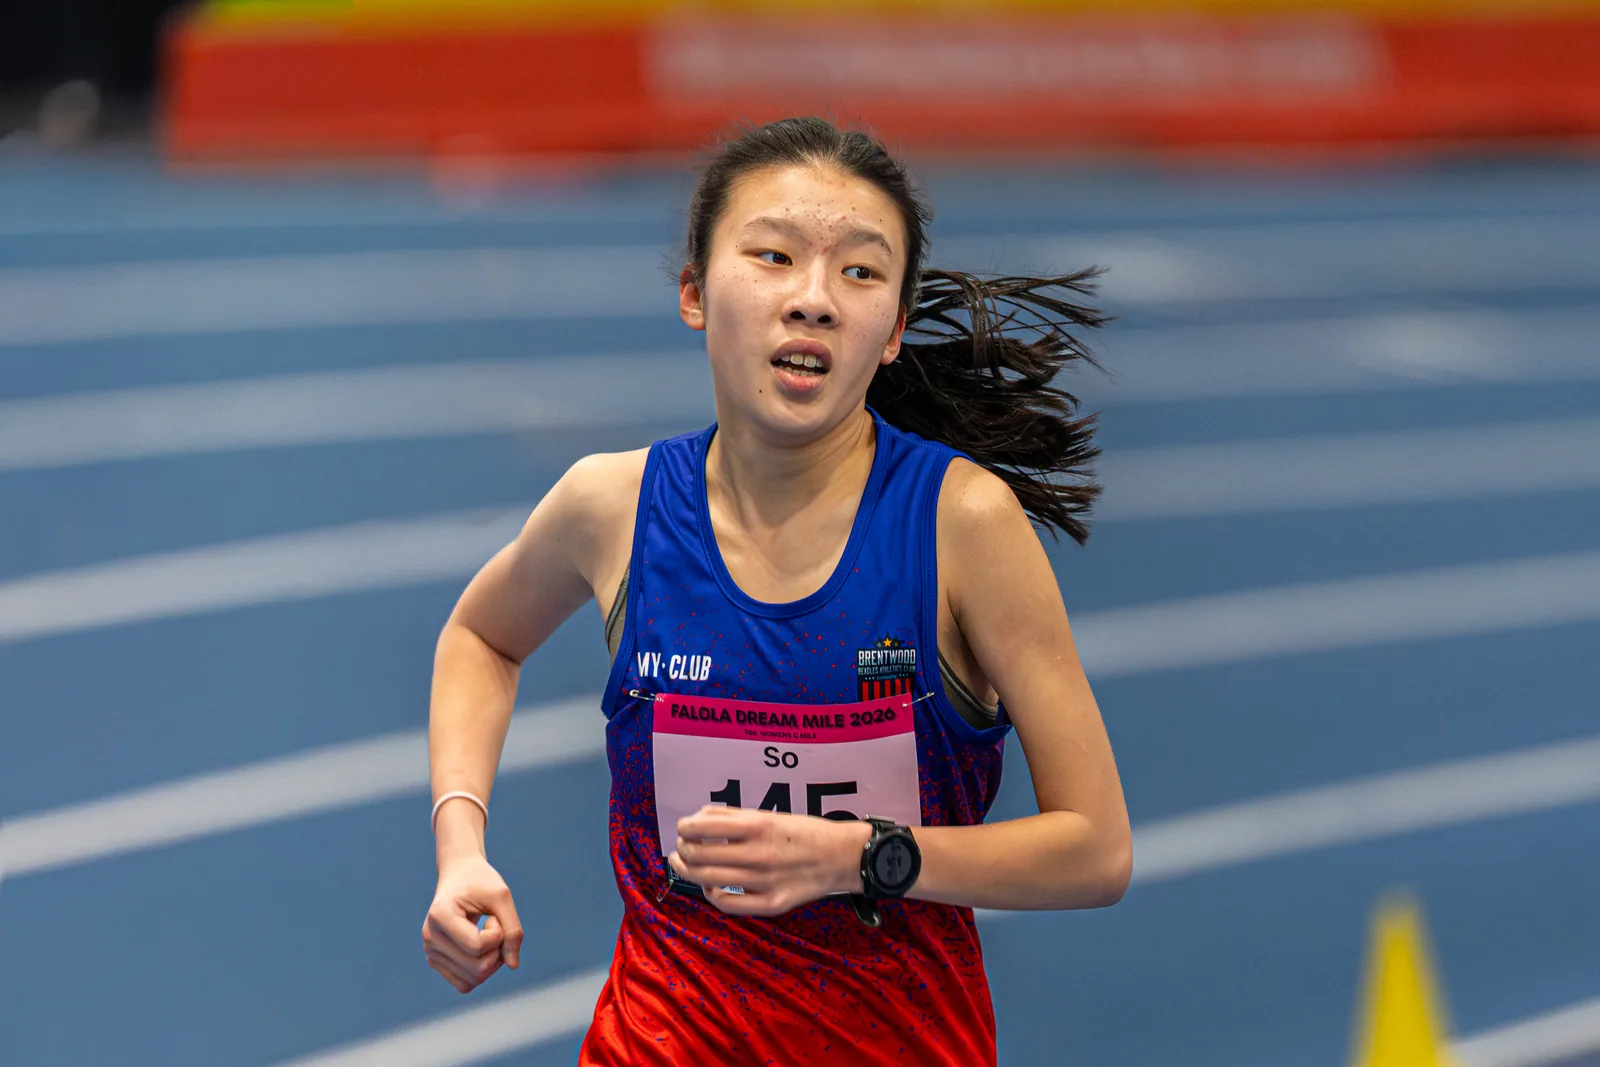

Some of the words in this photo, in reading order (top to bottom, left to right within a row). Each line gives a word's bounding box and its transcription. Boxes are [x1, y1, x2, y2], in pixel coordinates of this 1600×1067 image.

[858, 649, 916, 666] BRENTWOOD
[671, 703, 732, 723] FALOLA
[735, 709, 798, 728] DREAM
[802, 713, 845, 728] MILE
[849, 706, 897, 727] 2026
[763, 746, 799, 769] So
